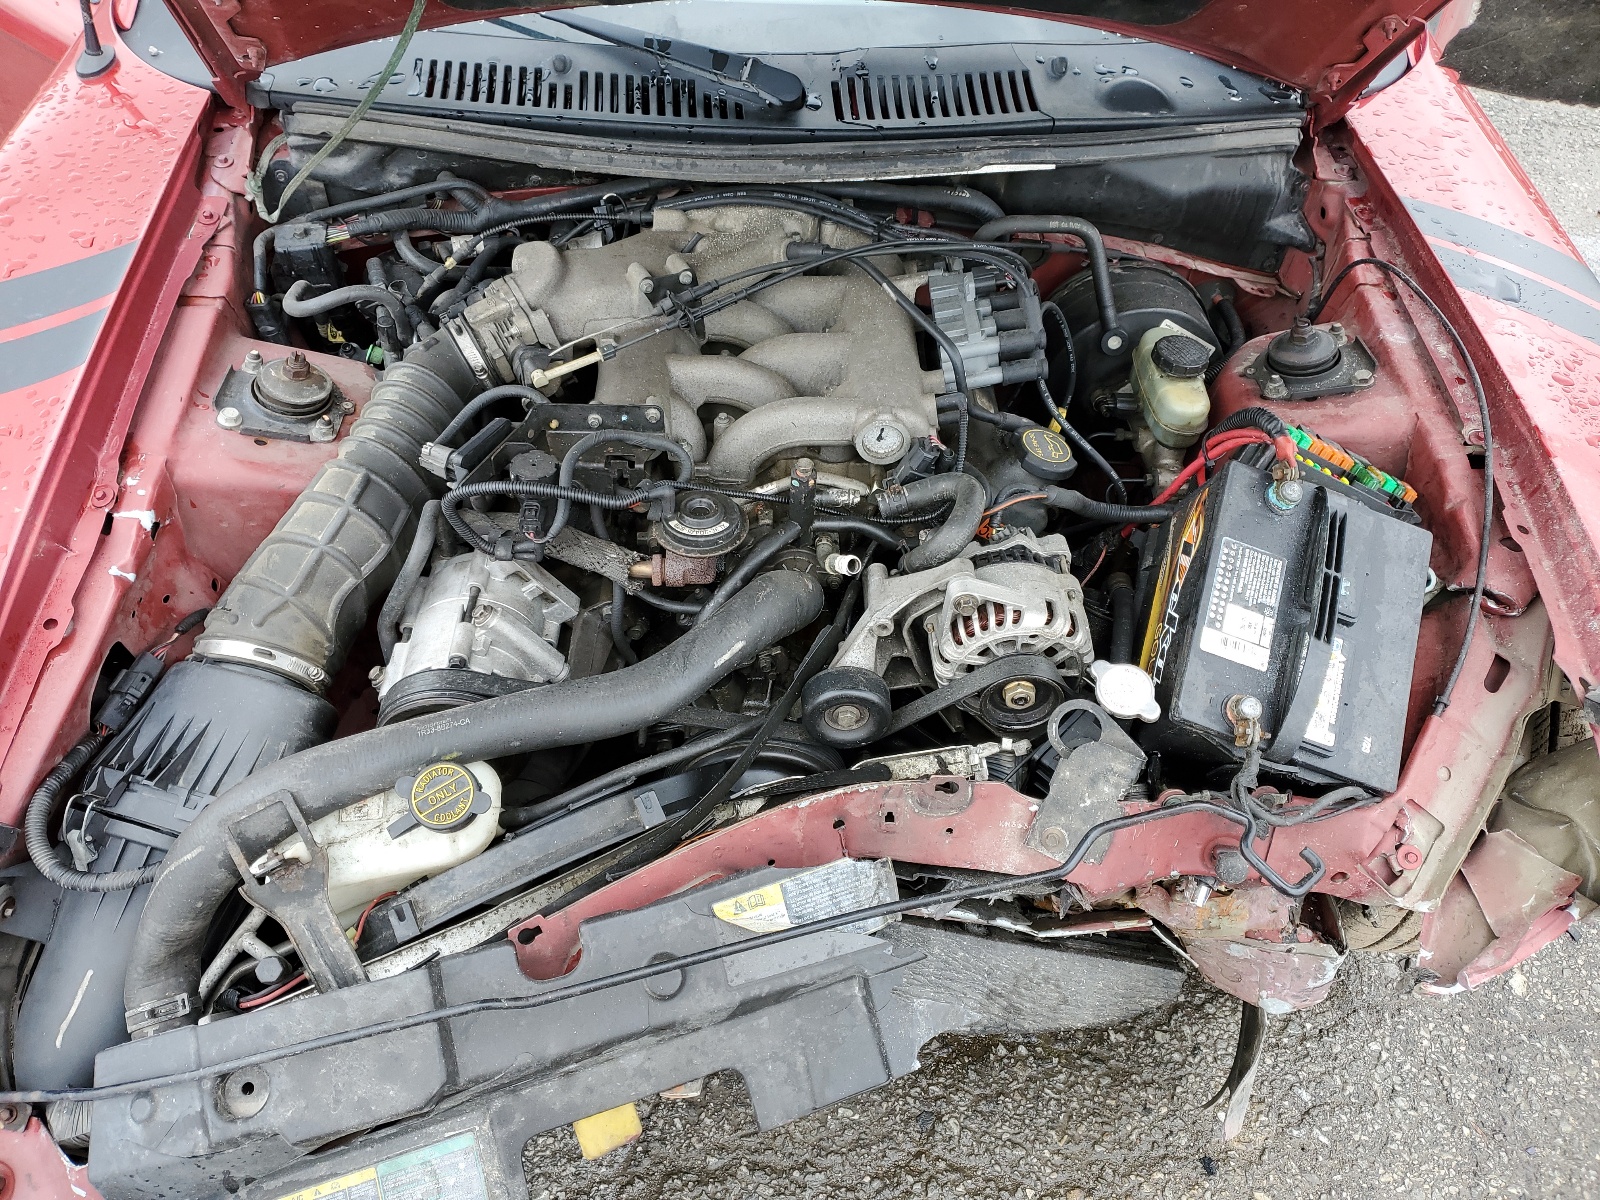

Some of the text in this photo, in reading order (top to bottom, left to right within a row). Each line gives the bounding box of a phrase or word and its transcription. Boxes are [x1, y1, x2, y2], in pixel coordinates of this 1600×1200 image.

[415, 767, 454, 793] RADIATOR
[428, 782, 457, 805] ONLY
[434, 797, 469, 822] COOLANT
